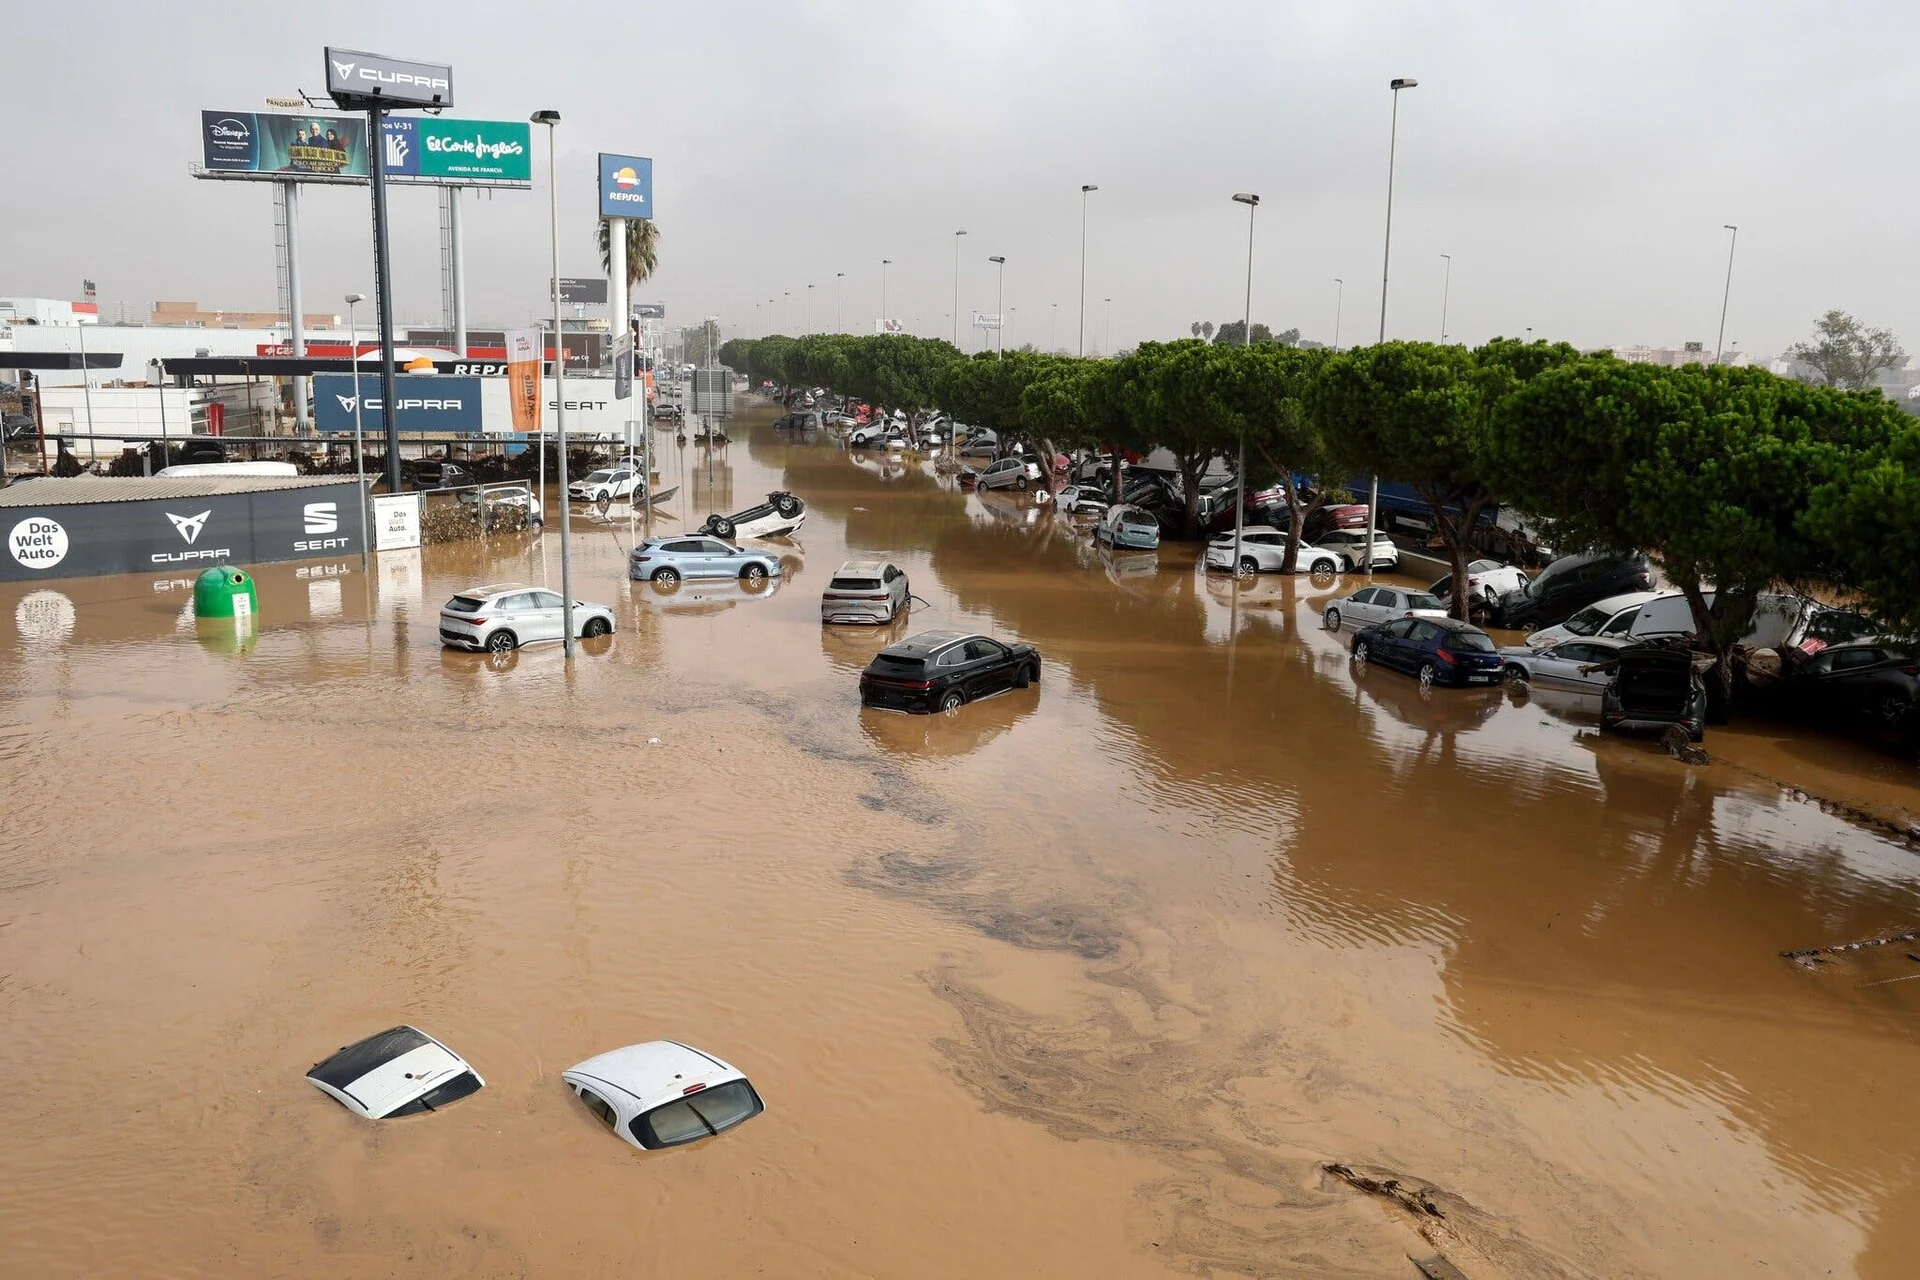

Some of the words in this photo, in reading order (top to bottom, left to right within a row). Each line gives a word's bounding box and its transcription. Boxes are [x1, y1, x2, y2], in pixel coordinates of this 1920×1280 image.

[359, 67, 449, 90] CUPRA
[266, 98, 304, 107] PANORAMIX
[393, 122, 412, 130] V-31
[426, 135, 442, 152] El
[442, 137, 475, 153] Corte
[447, 165, 472, 173] AVENIDA
[609, 192, 645, 203] REPSOL
[454, 364, 508, 375] REPS
[549, 401, 608, 411] SEAT
[29, 522, 59, 534] Das
[15, 534, 53, 547] Welt
[293, 537, 349, 551] SEAT
[17, 548, 60, 560] Auto.
[151, 549, 231, 563] CUPRA
